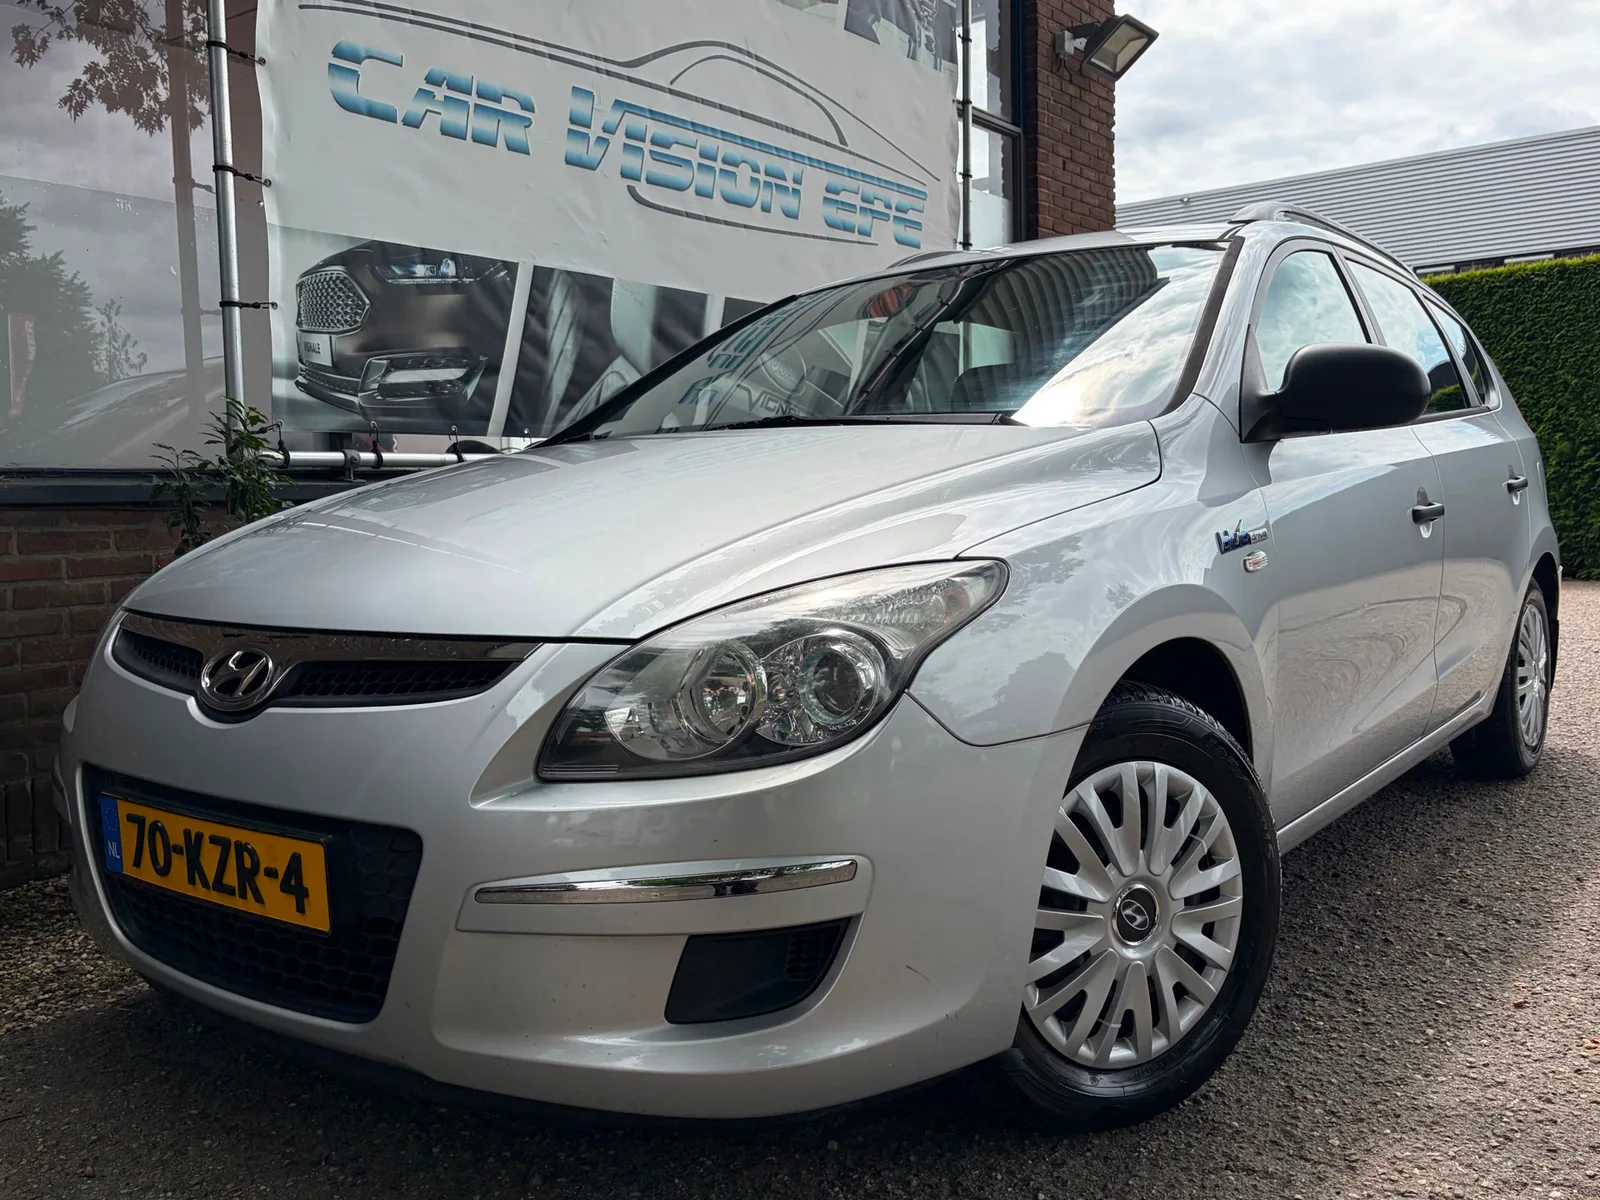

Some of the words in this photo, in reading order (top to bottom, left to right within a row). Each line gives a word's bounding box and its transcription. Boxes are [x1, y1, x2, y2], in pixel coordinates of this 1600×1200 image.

[328, 40, 536, 156] CAR
[565, 86, 804, 220] VISION
[822, 180, 926, 249] EPE
[107, 840, 121, 859] NL
[126, 812, 309, 915] 70-KZR-4
